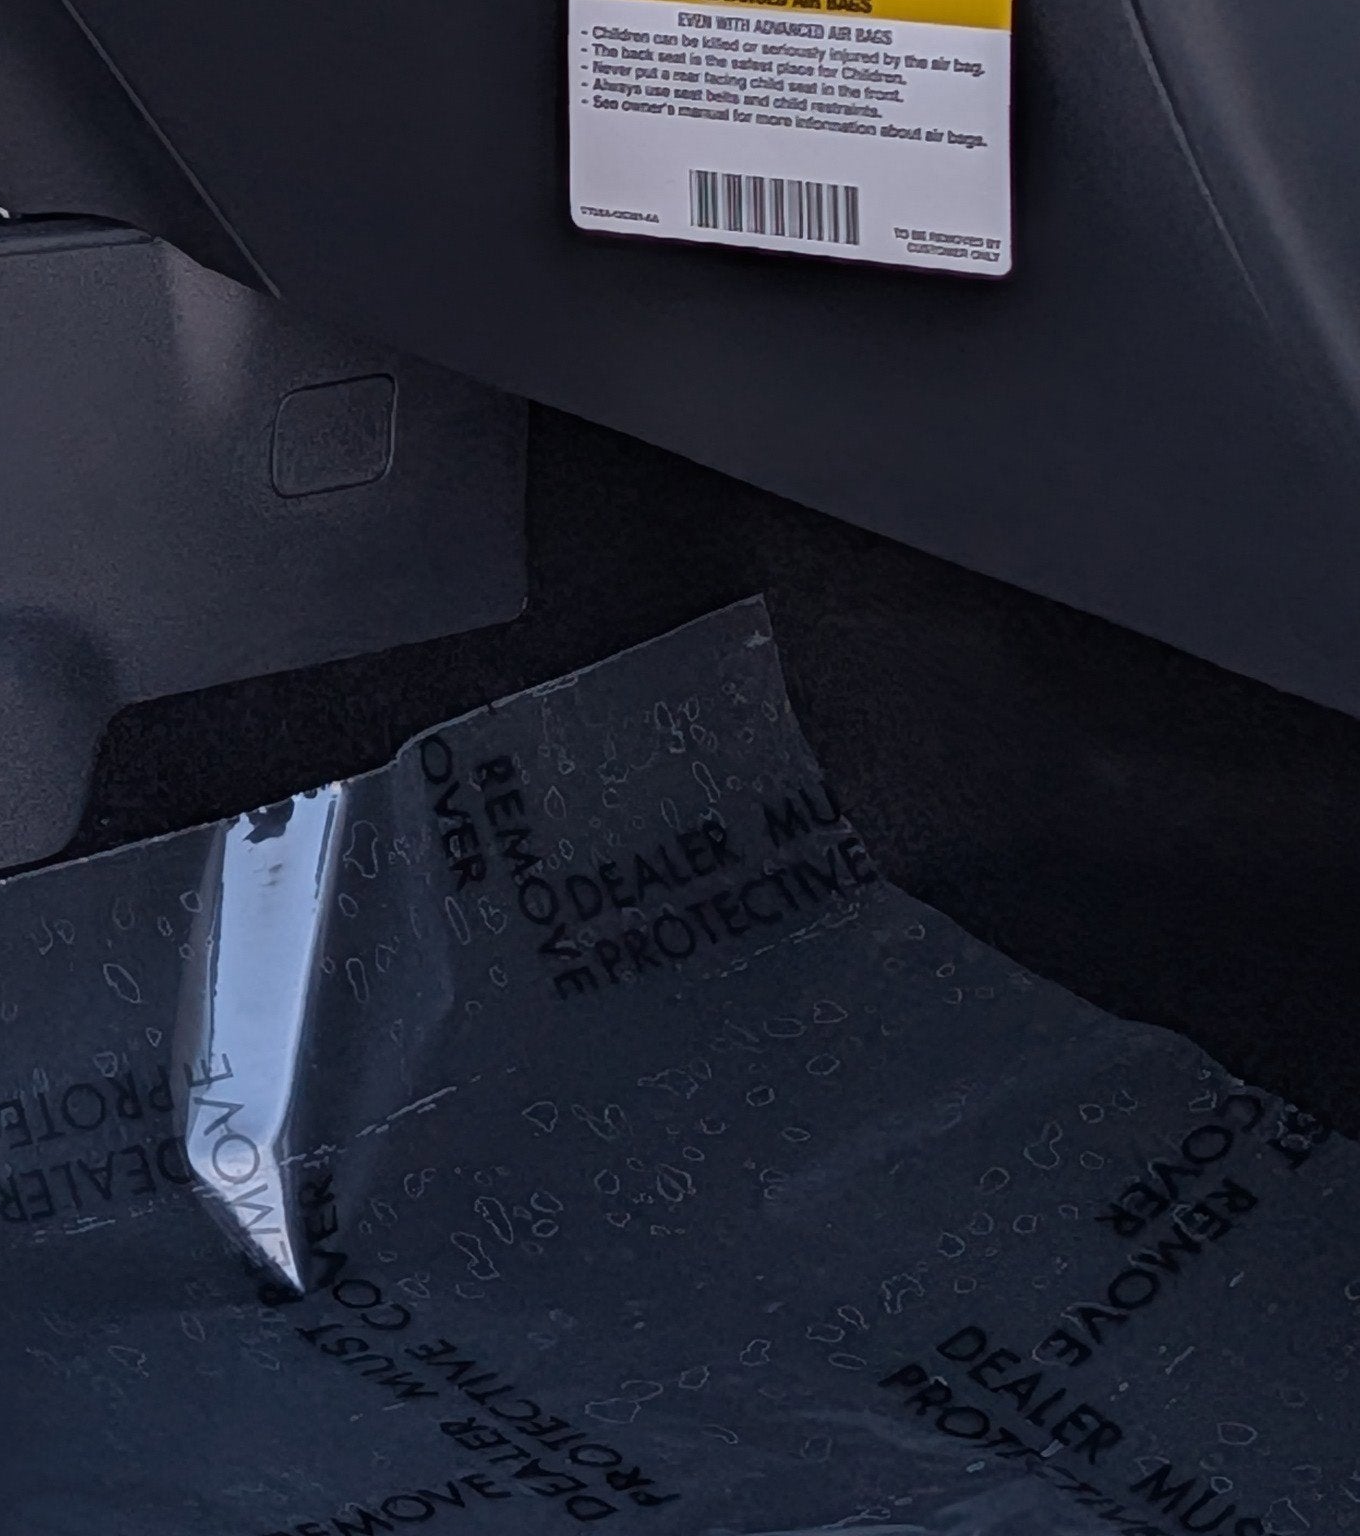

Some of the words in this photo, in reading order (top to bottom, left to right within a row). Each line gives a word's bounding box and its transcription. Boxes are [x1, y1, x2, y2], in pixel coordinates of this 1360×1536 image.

[591, 43, 619, 59] The
[621, 46, 654, 61] back
[657, 51, 687, 65] seat
[705, 54, 728, 69] the
[818, 64, 839, 79] for
[592, 25, 651, 44] Children
[653, 33, 679, 46] can
[681, 34, 700, 48] be
[702, 36, 740, 52] killed
[742, 42, 759, 53] or
[762, 43, 826, 63] seriously
[829, 47, 880, 65] injured
[883, 52, 902, 70] by
[904, 54, 928, 70] the
[931, 56, 952, 71] air
[677, 11, 712, 29] EVEN
[715, 15, 751, 32] WITH
[753, 18, 825, 40] ADVANCED
[827, 25, 852, 42] AIR
[855, 27, 894, 46] BAGS
[592, 60, 633, 77] Never
[634, 66, 659, 81] put
[661, 69, 671, 81] a
[704, 71, 748, 91] facing
[749, 77, 785, 92] child
[821, 82, 835, 96] in
[837, 84, 862, 99] the
[592, 78, 643, 98] Always
[644, 85, 671, 98] use
[673, 87, 704, 101] seat
[705, 89, 741, 105] belts
[743, 93, 770, 107] and
[773, 96, 808, 112] child
[592, 94, 620, 110] See
[677, 106, 731, 121] manual
[733, 108, 753, 123] for
[755, 113, 793, 127] more
[795, 115, 877, 136] information
[880, 124, 922, 141] about
[924, 128, 944, 143] air
[478, 754, 602, 1002] REMOVE
[564, 817, 742, 922] DEALER
[593, 834, 879, 985] PROTECTIVE
[1092, 1091, 1266, 1240] COVER
[1030, 1175, 1260, 1369] REMOVE
[294, 1320, 440, 1404] MUST
[934, 1323, 1124, 1468] DEALER
[403, 1336, 681, 1508] PROTECTIVE
[438, 1415, 620, 1522] DEALER
[262, 1471, 514, 1536] EMOVE
